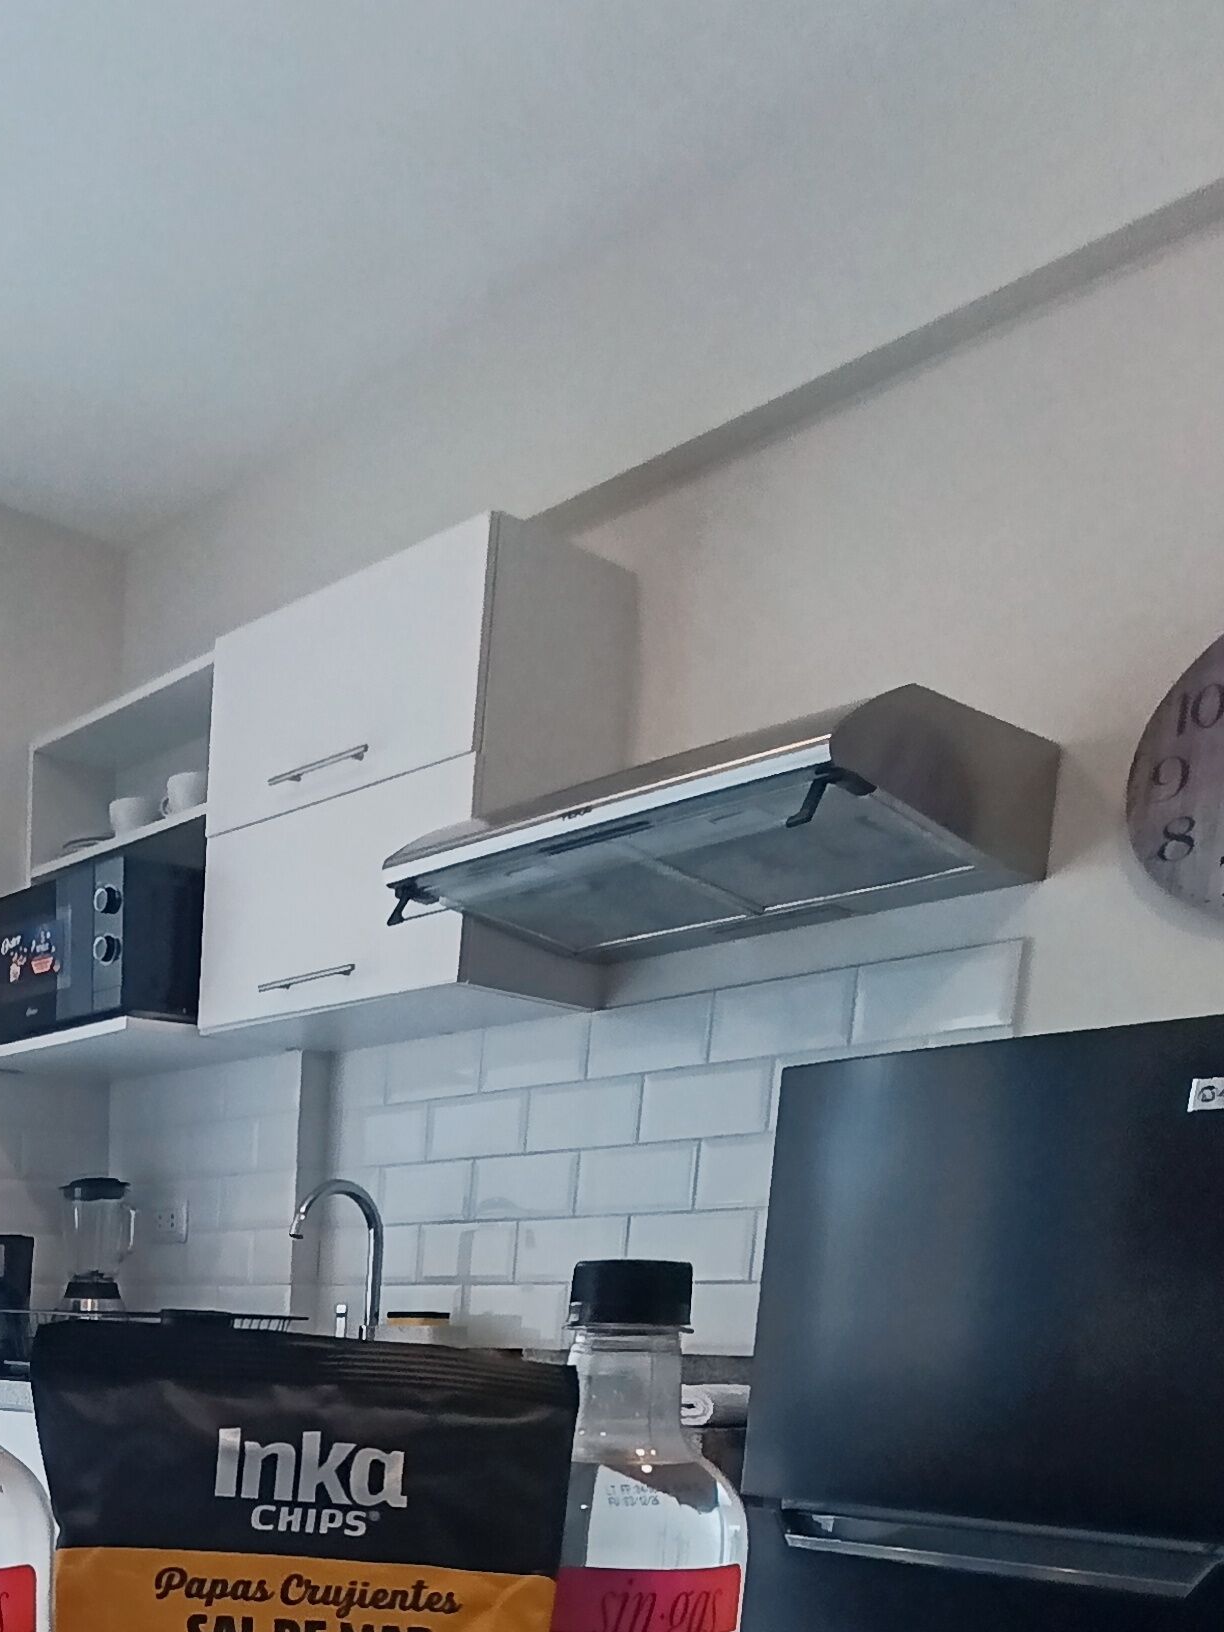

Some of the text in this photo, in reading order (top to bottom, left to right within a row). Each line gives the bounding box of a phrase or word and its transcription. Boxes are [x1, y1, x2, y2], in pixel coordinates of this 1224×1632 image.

[1178, 683, 1224, 737] 10
[1152, 756, 1190, 802] 9
[1157, 815, 1195, 862] 8
[214, 1427, 408, 1508] Inka
[251, 1504, 368, 1537] CHIPS
[154, 1566, 462, 1619] Papas Crujientes
